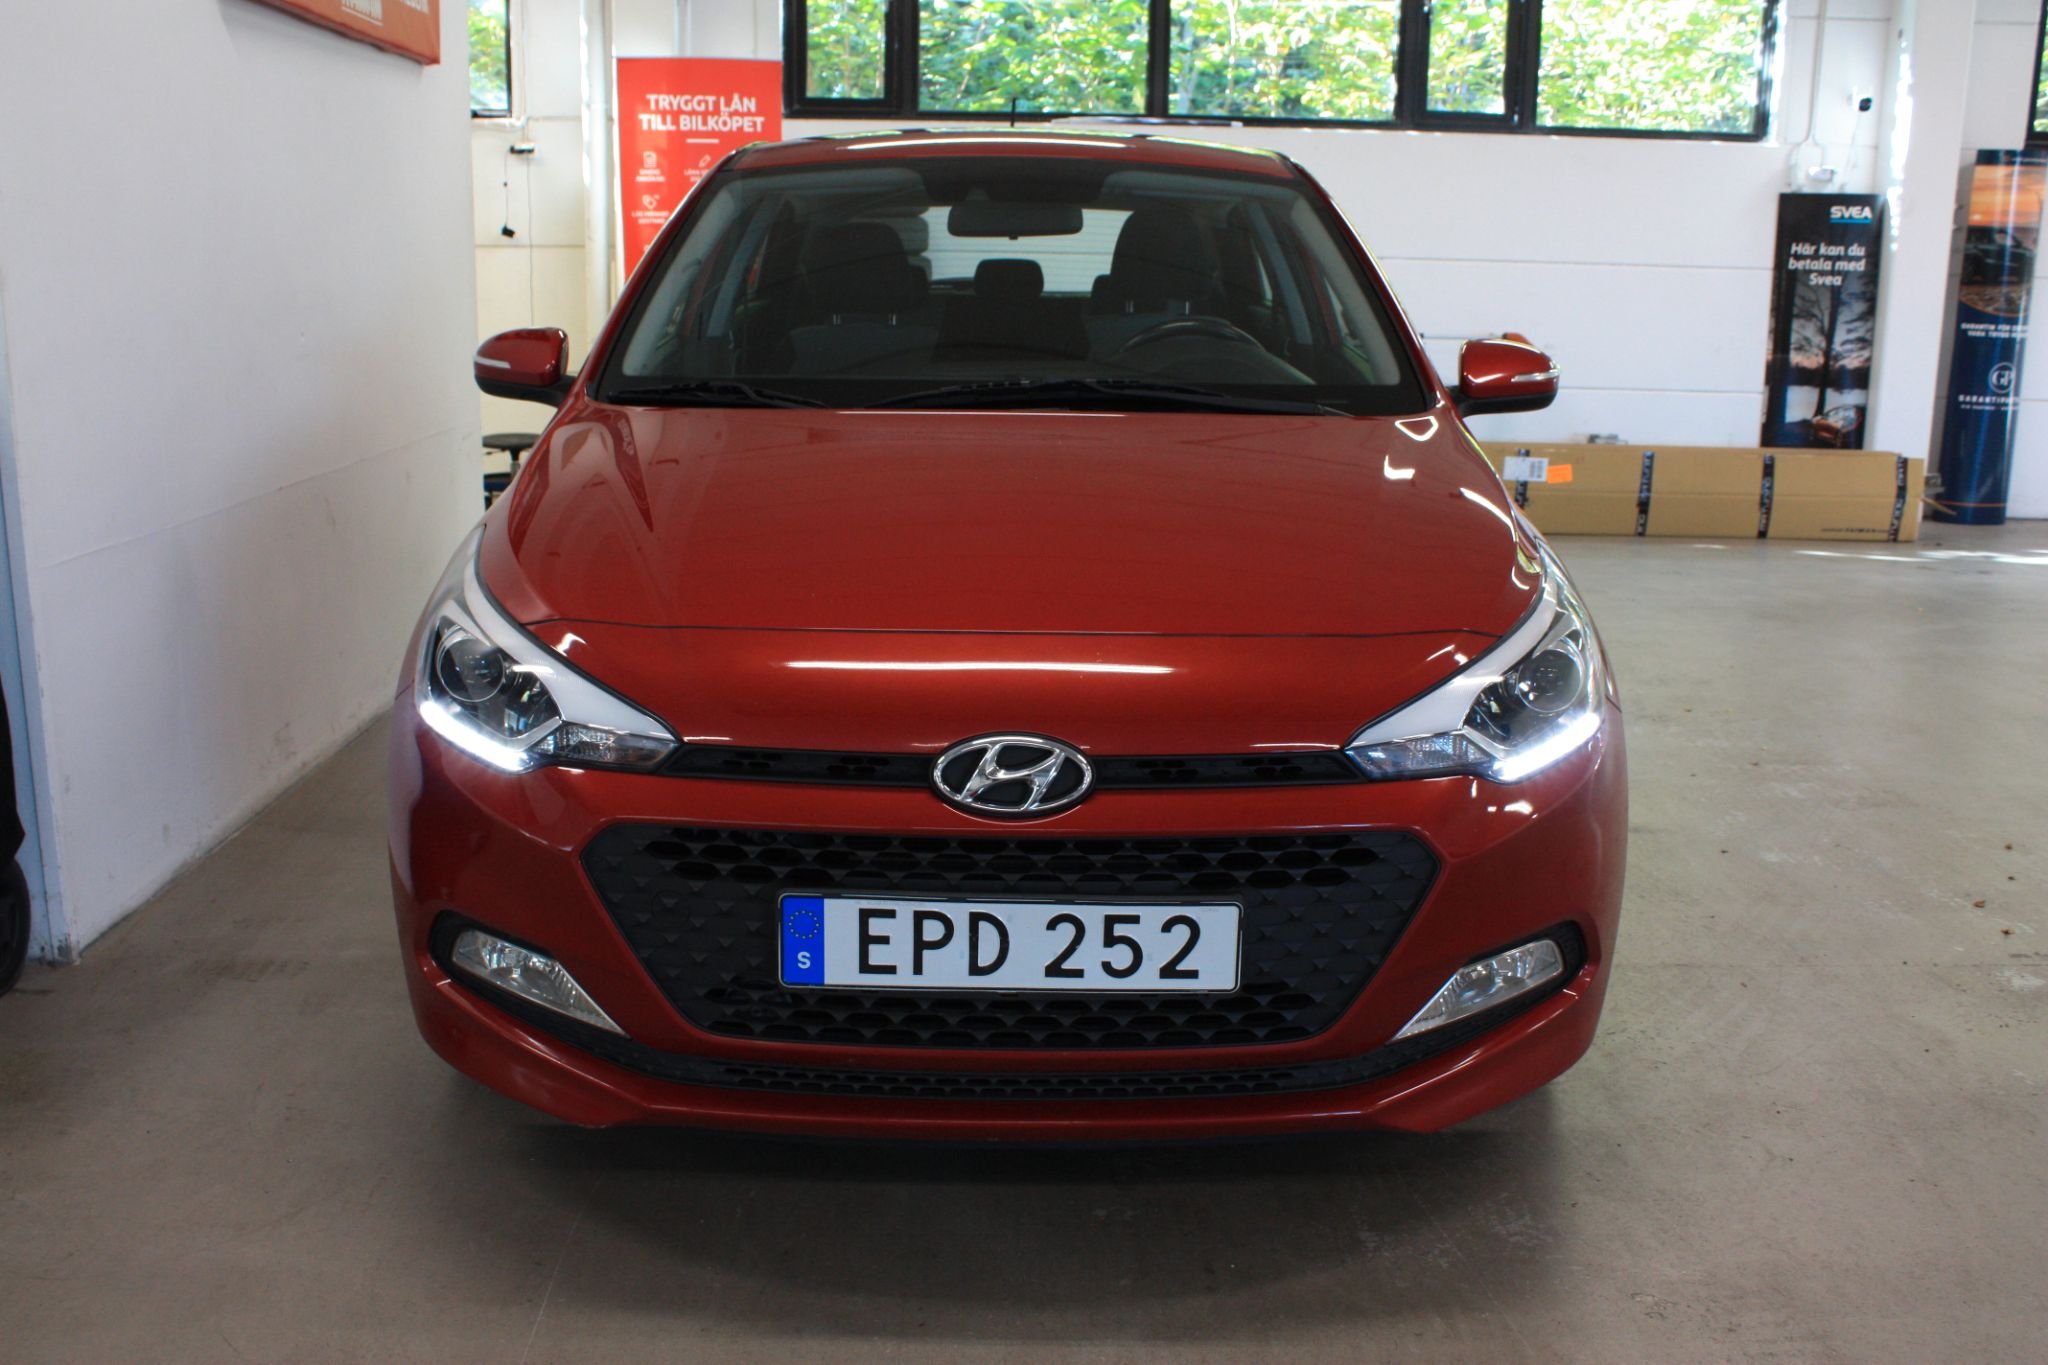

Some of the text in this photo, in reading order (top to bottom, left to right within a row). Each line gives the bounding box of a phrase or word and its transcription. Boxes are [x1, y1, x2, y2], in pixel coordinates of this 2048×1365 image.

[646, 93, 757, 113] TRYGGT LÅN
[638, 111, 766, 133] TILL BILKÖPET
[1829, 206, 1873, 219] SVEA
[1790, 242, 1867, 257] Här kan du
[1788, 257, 1867, 272] betala med
[1808, 272, 1843, 287] Svea
[858, 907, 1201, 980] EPD 252
[796, 951, 812, 970] S
